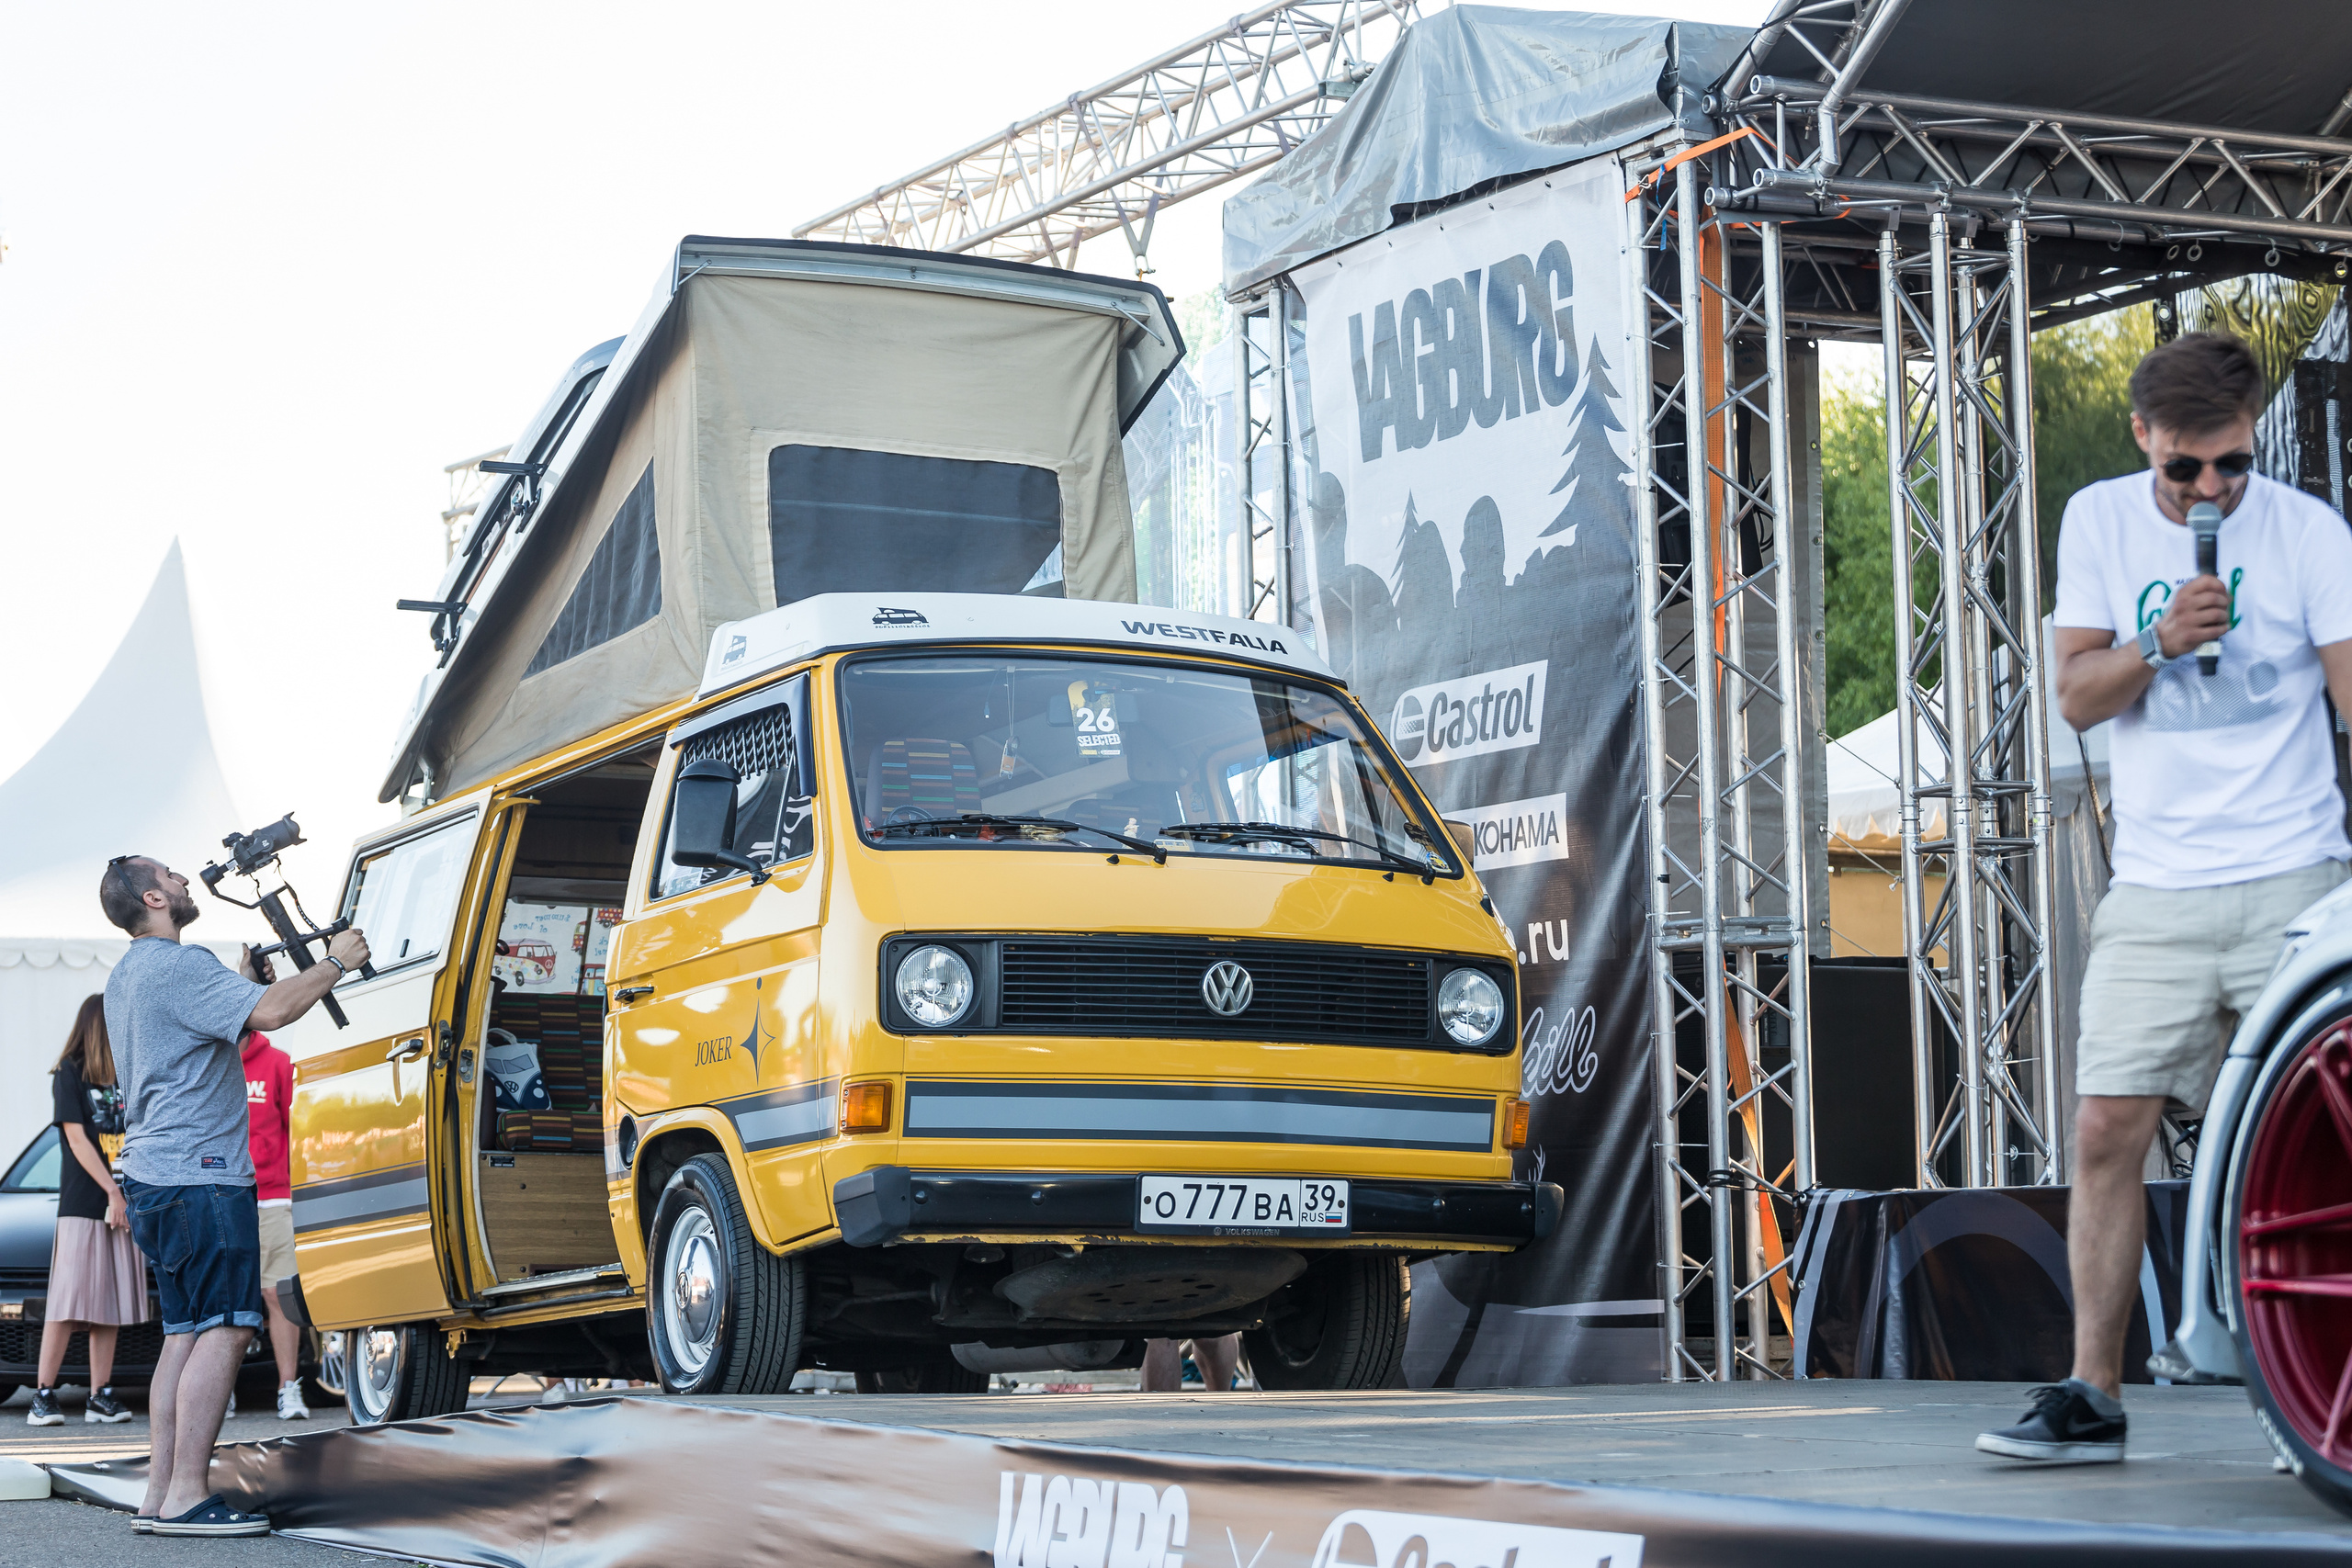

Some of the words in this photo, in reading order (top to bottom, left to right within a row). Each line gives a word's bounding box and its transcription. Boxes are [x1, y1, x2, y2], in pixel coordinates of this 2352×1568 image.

[1348, 240, 1579, 463] VAGBURG
[1121, 620, 1288, 655] WESTFALIA
[1076, 707, 1115, 732] 26
[1427, 672, 1535, 753] Castrol
[1077, 733, 1121, 747] SELECTED
[1474, 810, 1560, 856] KOHAMA
[1518, 919, 1569, 964] .ru
[695, 1036, 732, 1066] JOKER
[1305, 1184, 1336, 1212] 39
[1225, 1227, 1281, 1236] VOLKSWAGEN
[1301, 1212, 1325, 1223] RUS
